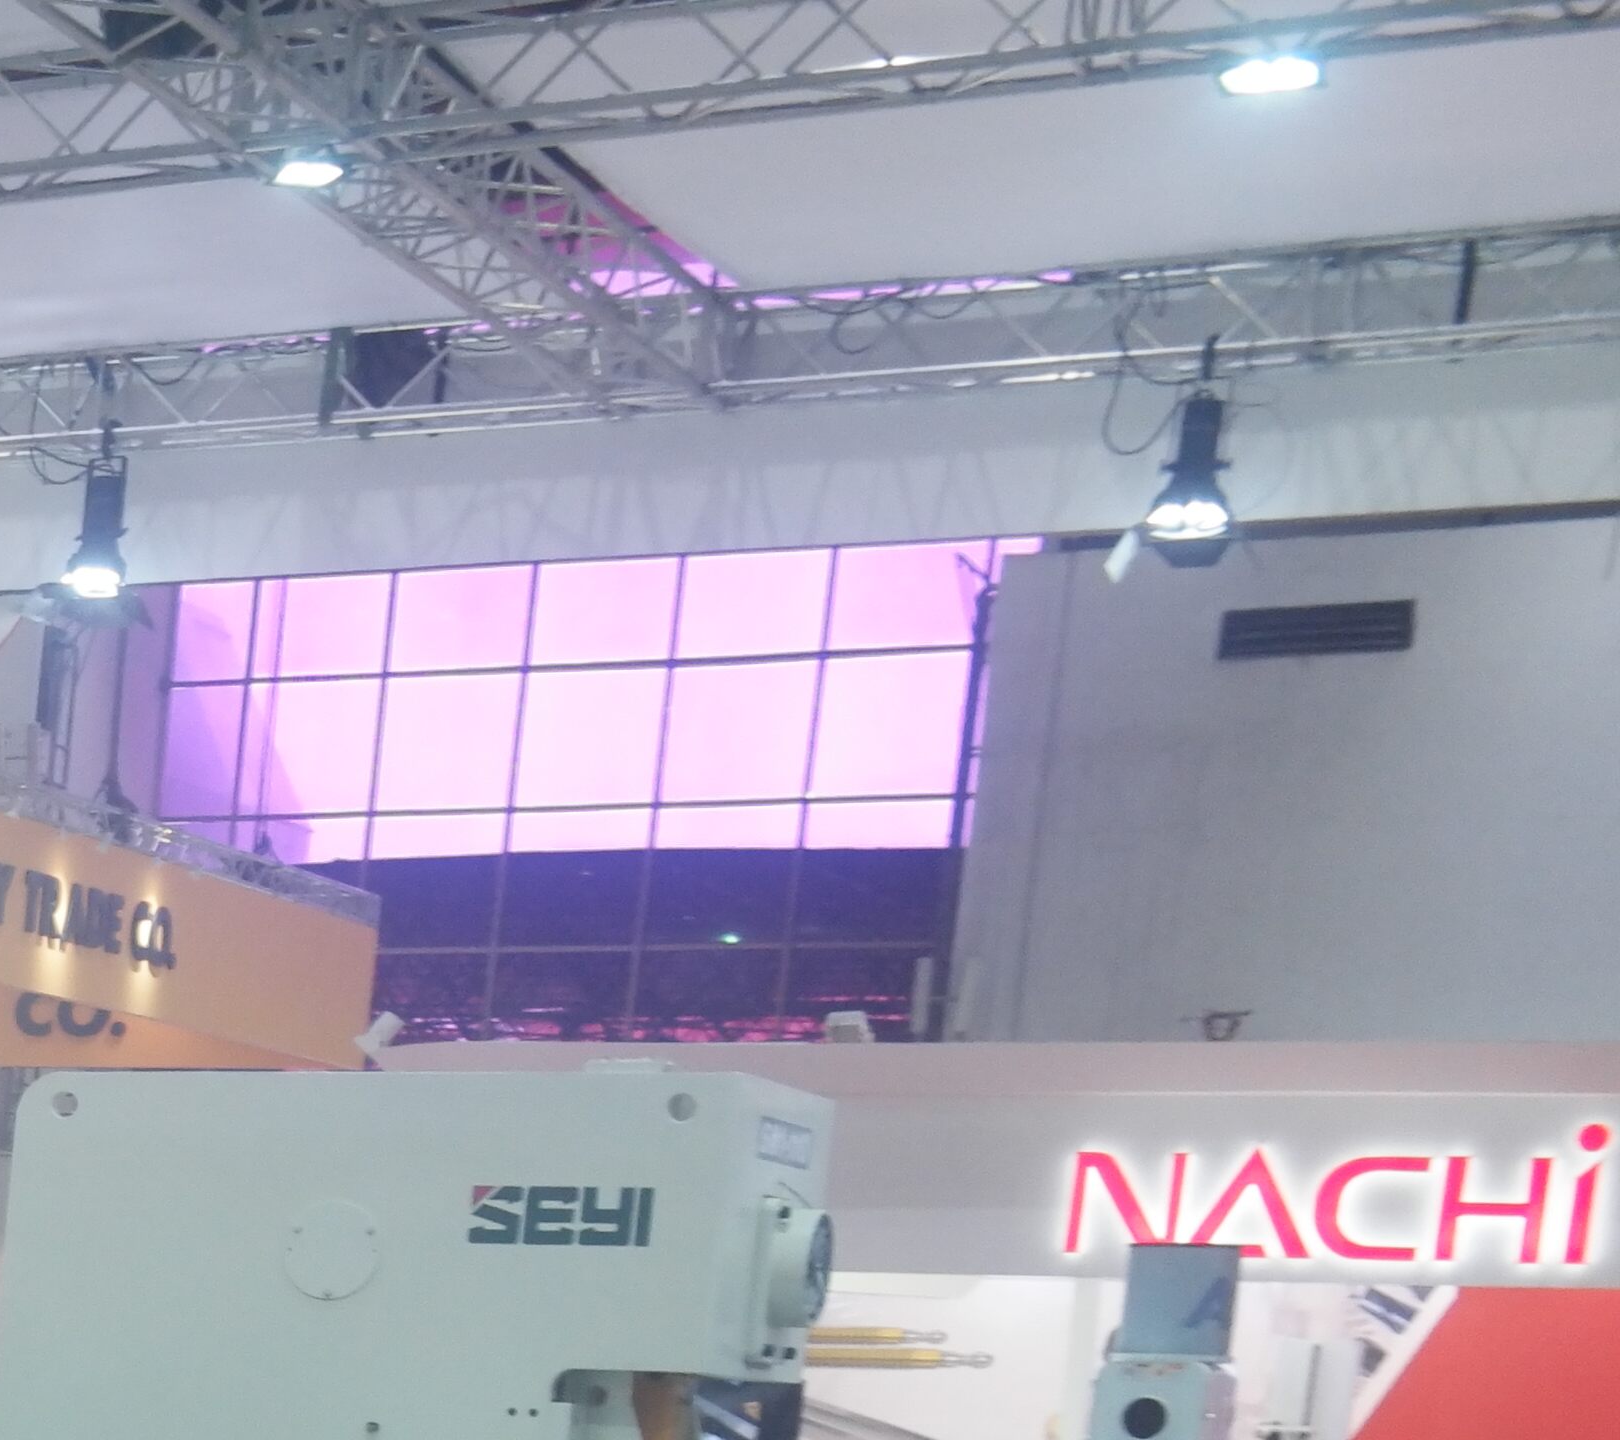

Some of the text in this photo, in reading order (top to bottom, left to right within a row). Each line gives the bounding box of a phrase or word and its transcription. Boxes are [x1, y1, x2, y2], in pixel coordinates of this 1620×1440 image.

[24, 870, 127, 960] TRADE
[128, 900, 179, 972] CO.
[15, 991, 126, 1039] CO.
[467, 1185, 656, 1247] SEYI
